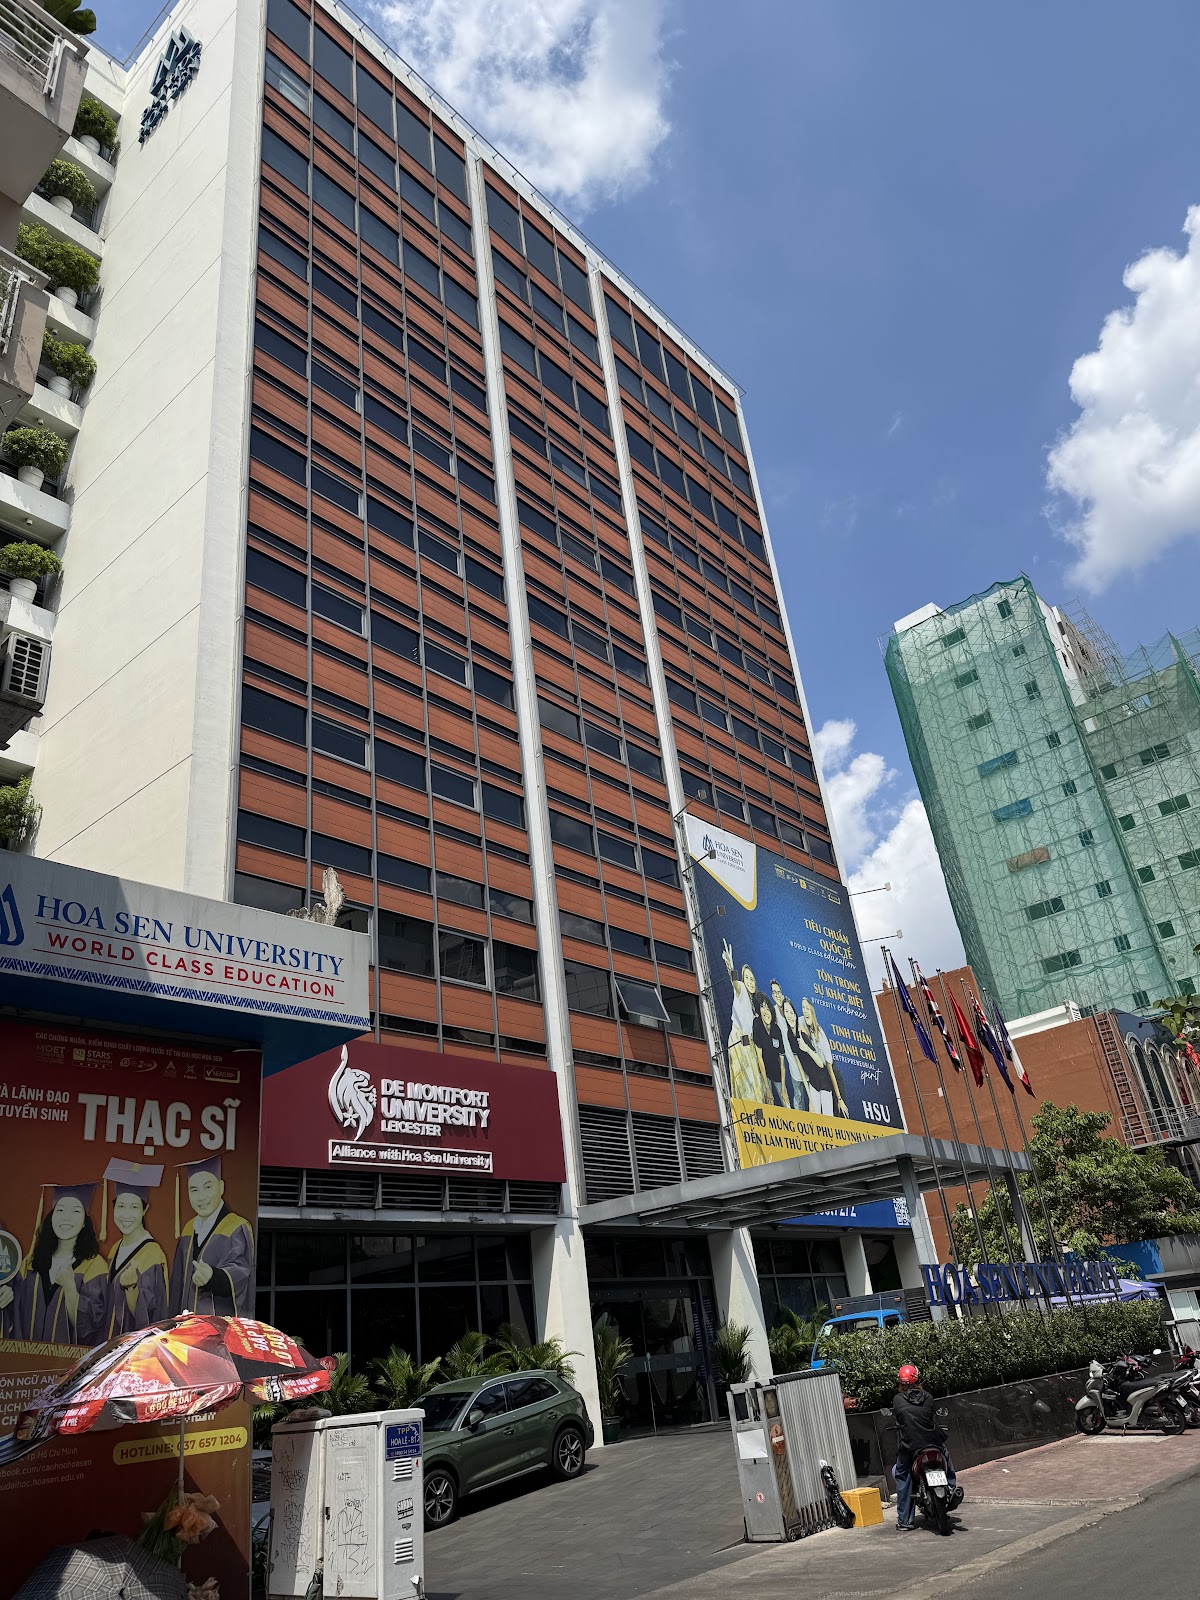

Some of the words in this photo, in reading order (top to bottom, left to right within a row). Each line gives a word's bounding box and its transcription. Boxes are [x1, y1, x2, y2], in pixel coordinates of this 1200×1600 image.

[35, 894, 107, 931] HOA
[114, 911, 174, 944] SEN
[183, 925, 345, 976] UNIVERSITY
[47, 931, 136, 962] WORLD
[145, 951, 215, 976] CLASS
[223, 965, 336, 998] EDUCATION
[86, 1049, 111, 1059] STARS
[11, 1084, 44, 1102] LÃNH
[46, 1089, 70, 1106] ĐẠO
[381, 1078, 406, 1097] DE
[406, 1081, 490, 1108] MONTFORT
[0, 1101, 38, 1120] TUYỂN
[40, 1107, 69, 1122] SINH
[381, 1096, 491, 1128] UNIVERSITY
[862, 1100, 891, 1124] HSU
[77, 1092, 192, 1157] THẠC
[199, 1097, 242, 1151] SĨ
[381, 1119, 442, 1137] LEICESTER
[768, 1115, 796, 1132] MỪNG
[796, 1121, 815, 1138] QUÝ
[816, 1125, 834, 1142] PHỤ
[743, 1127, 763, 1145] ĐẾN
[764, 1131, 784, 1148] LÀM
[332, 1144, 377, 1159] Alliance
[378, 1148, 402, 1161] with
[402, 1149, 422, 1162] Hoa
[422, 1152, 443, 1164] Sen
[442, 1153, 491, 1169] University
[922, 1262, 977, 1306] HOA
[973, 1262, 1022, 1302] SEN
[1019, 1260, 1123, 1300] UNIVERSITY
[16, 1374, 40, 1387] NGỮ
[40, 1374, 58, 1385] AN
[15, 1389, 31, 1401] TRỊ
[32, 1388, 44, 1398] D
[397, 1427, 410, 1435] TPP
[61, 1446, 78, 1456] Minh
[120, 1443, 174, 1460] HOTLINE:
[198, 1436, 218, 1449] 657
[219, 1433, 242, 1446] 1204
